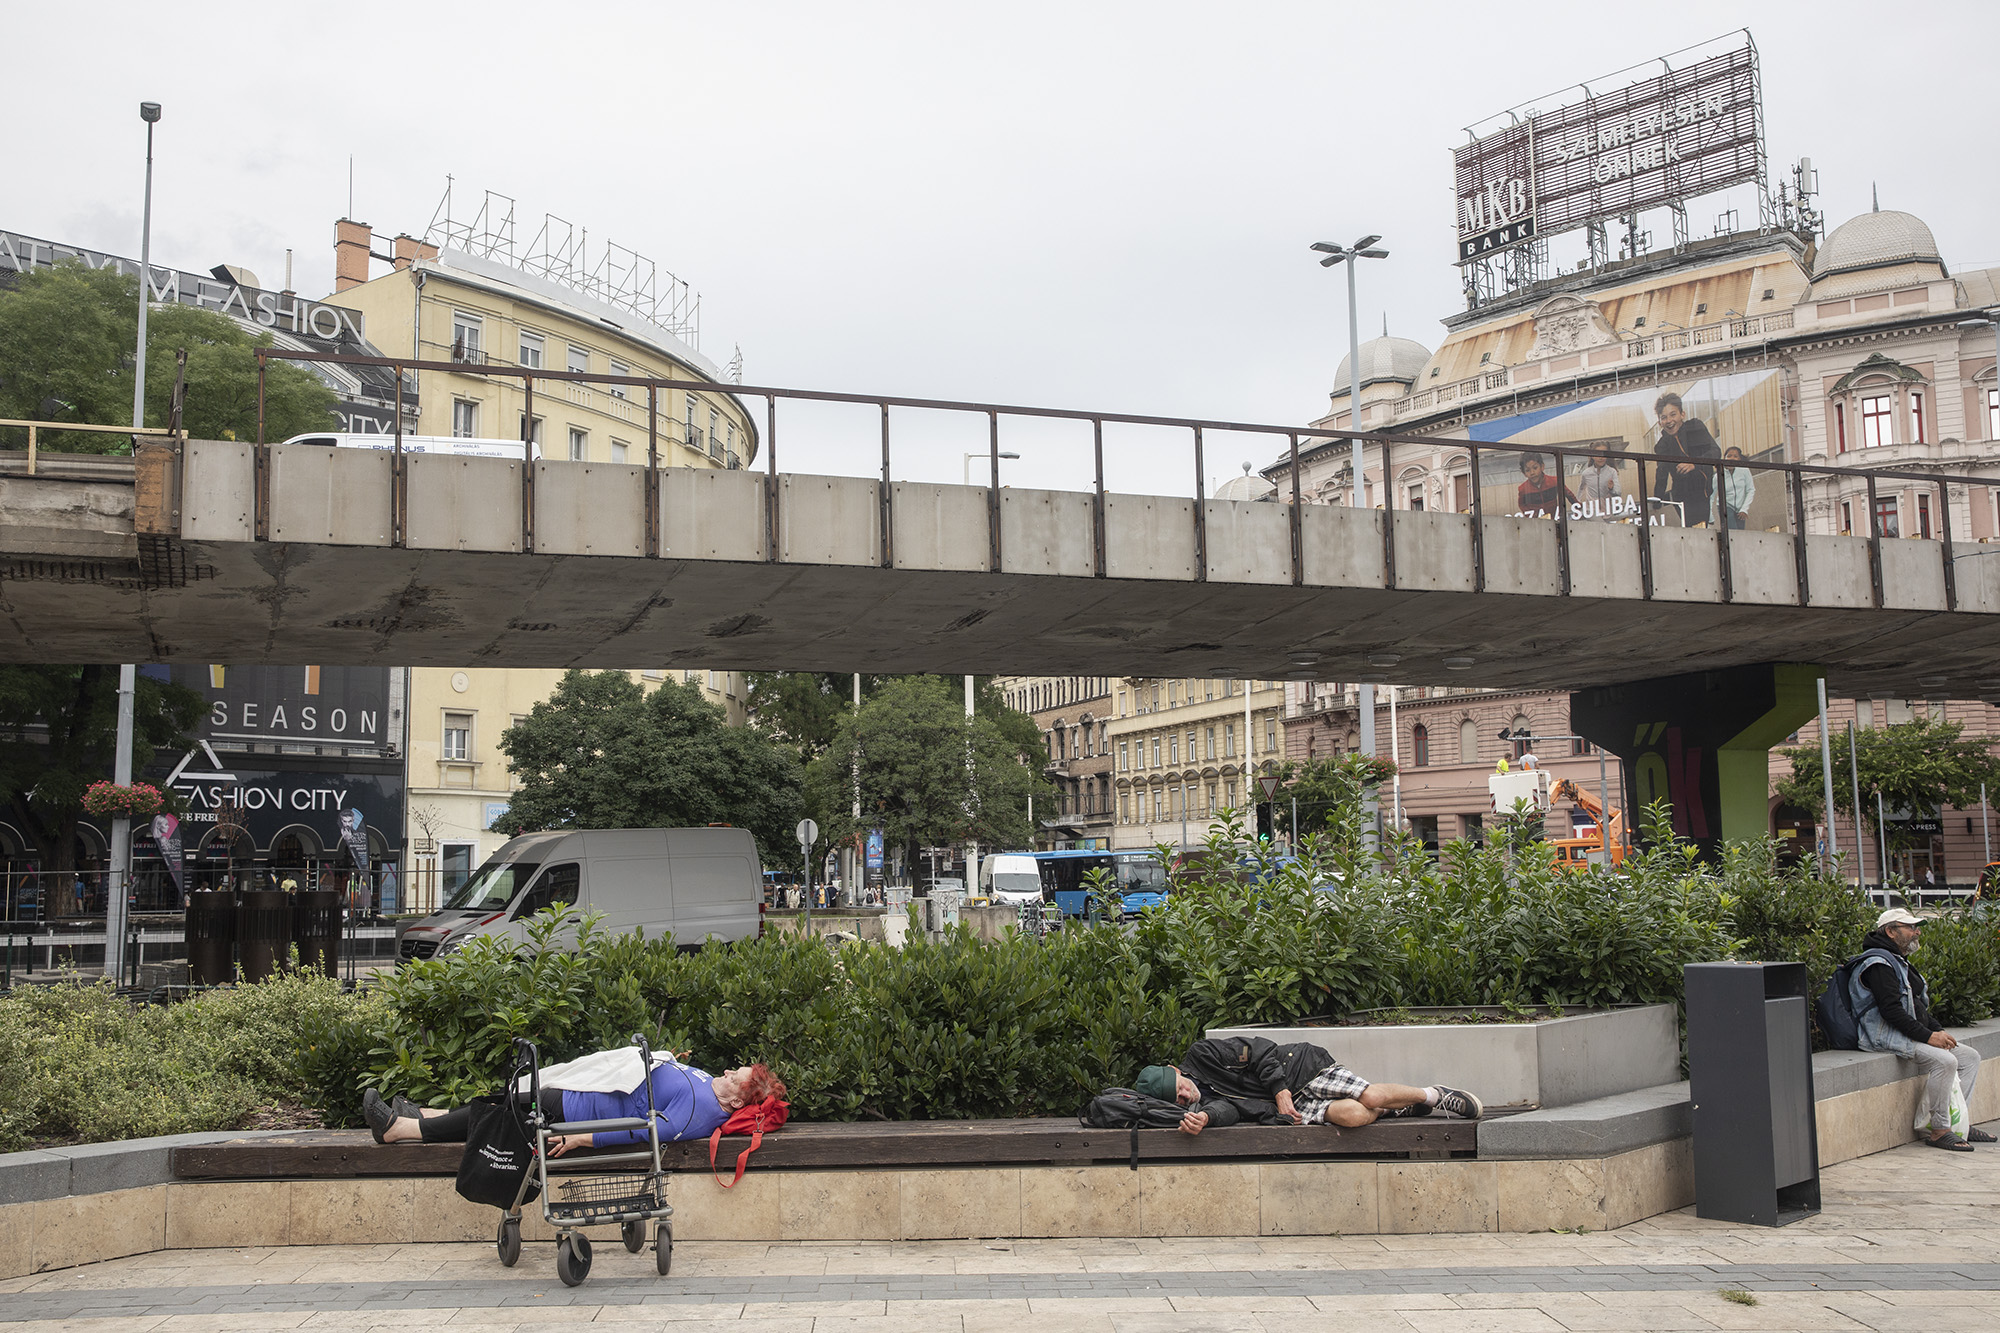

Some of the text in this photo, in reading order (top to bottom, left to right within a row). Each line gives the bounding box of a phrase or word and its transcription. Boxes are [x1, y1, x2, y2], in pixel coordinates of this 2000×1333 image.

[1555, 94, 1723, 165] SZEMÉLYESEN
[1463, 176, 1527, 234] MKB
[1467, 223, 1527, 255] BANK
[197, 277, 367, 346] FASHION
[210, 700, 377, 734] SEASON
[174, 784, 347, 811] FASHION CITY
